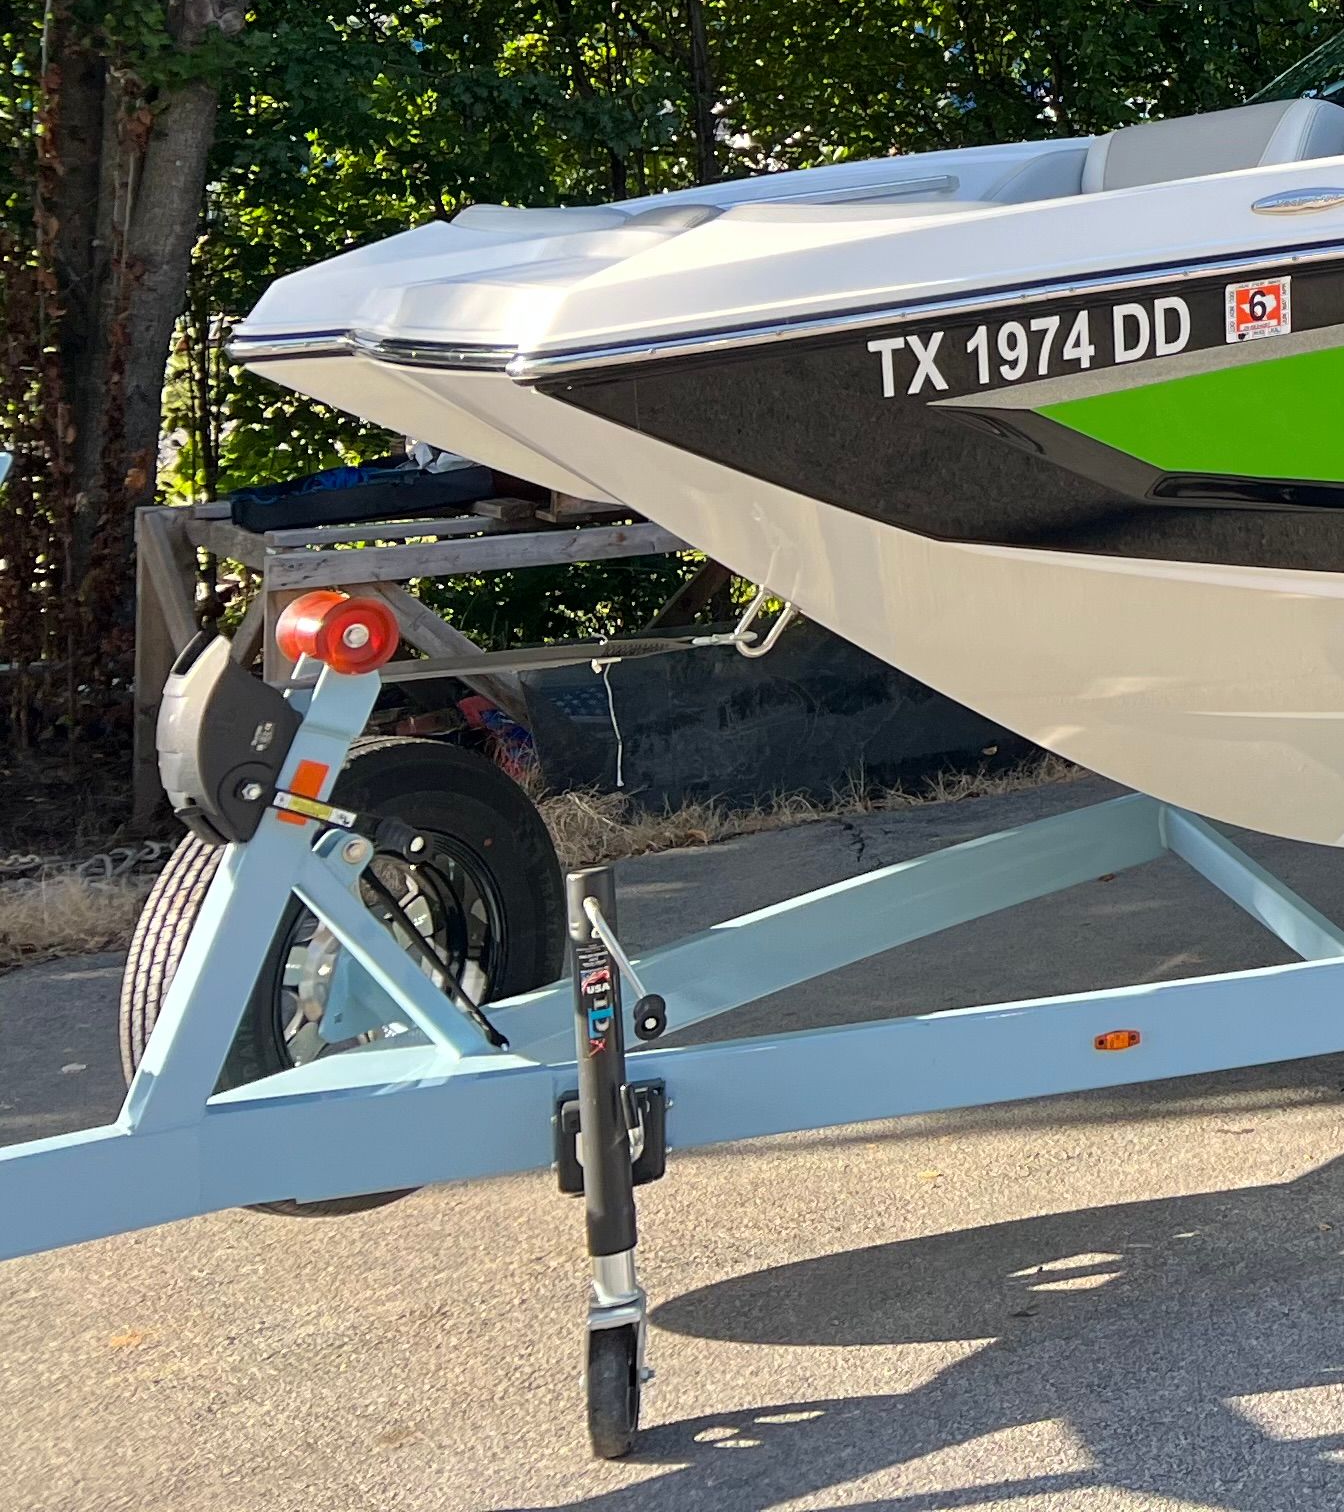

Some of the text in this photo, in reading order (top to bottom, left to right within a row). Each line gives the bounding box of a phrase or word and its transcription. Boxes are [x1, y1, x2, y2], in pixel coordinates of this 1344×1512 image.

[1248, 290, 1267, 322] 6
[867, 330, 949, 398] TX
[966, 309, 1096, 385] 1974
[1112, 296, 1191, 364] DD
[586, 981, 611, 995] USA
